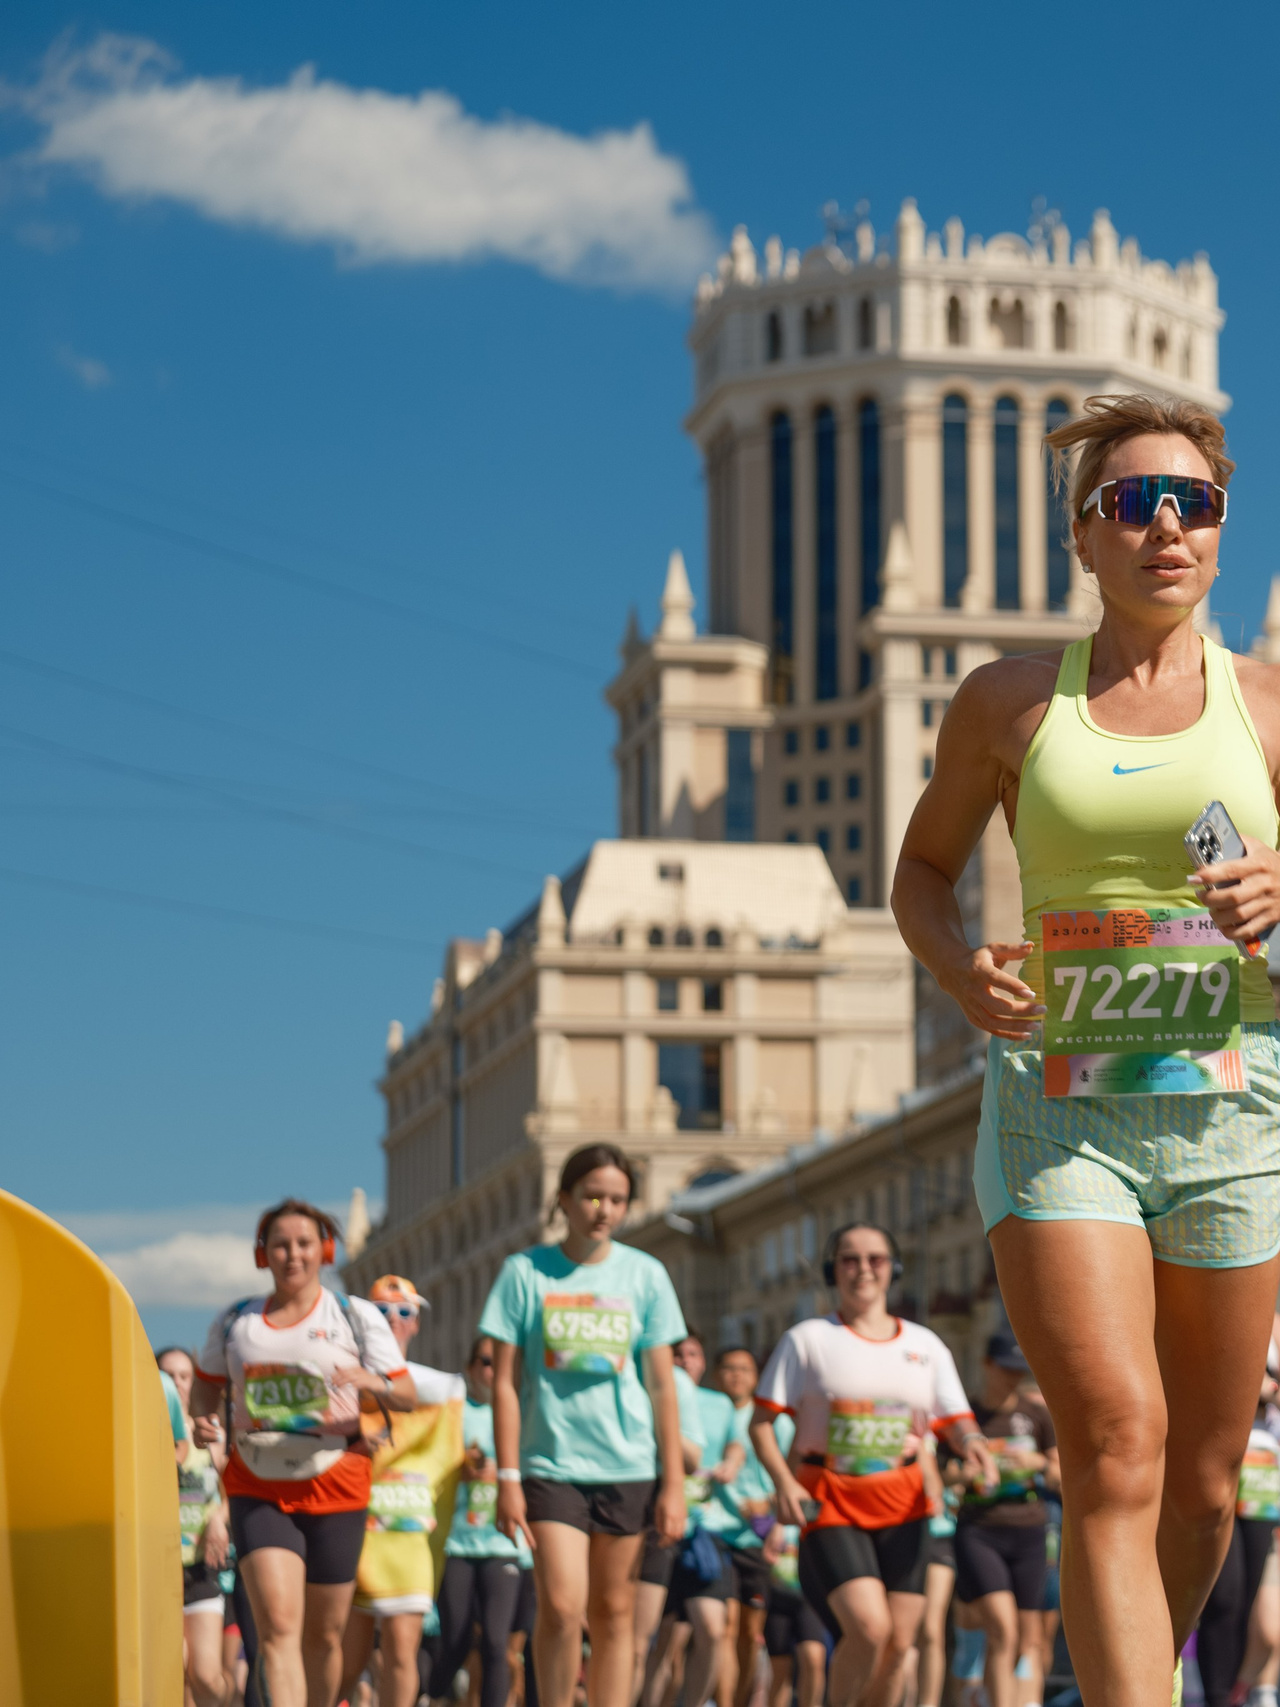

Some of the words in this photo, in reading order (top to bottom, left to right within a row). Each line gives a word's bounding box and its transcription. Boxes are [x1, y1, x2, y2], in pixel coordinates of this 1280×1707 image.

[1183, 920, 1194, 930] 5
[1052, 926, 1101, 937] 23/08
[1053, 962, 1230, 1022] 72279
[1056, 1034, 1144, 1044] ФЕСТИВАЛЬ
[1153, 1032, 1232, 1042] ДВИЖЕНИЯ
[547, 1311, 628, 1343] 67545
